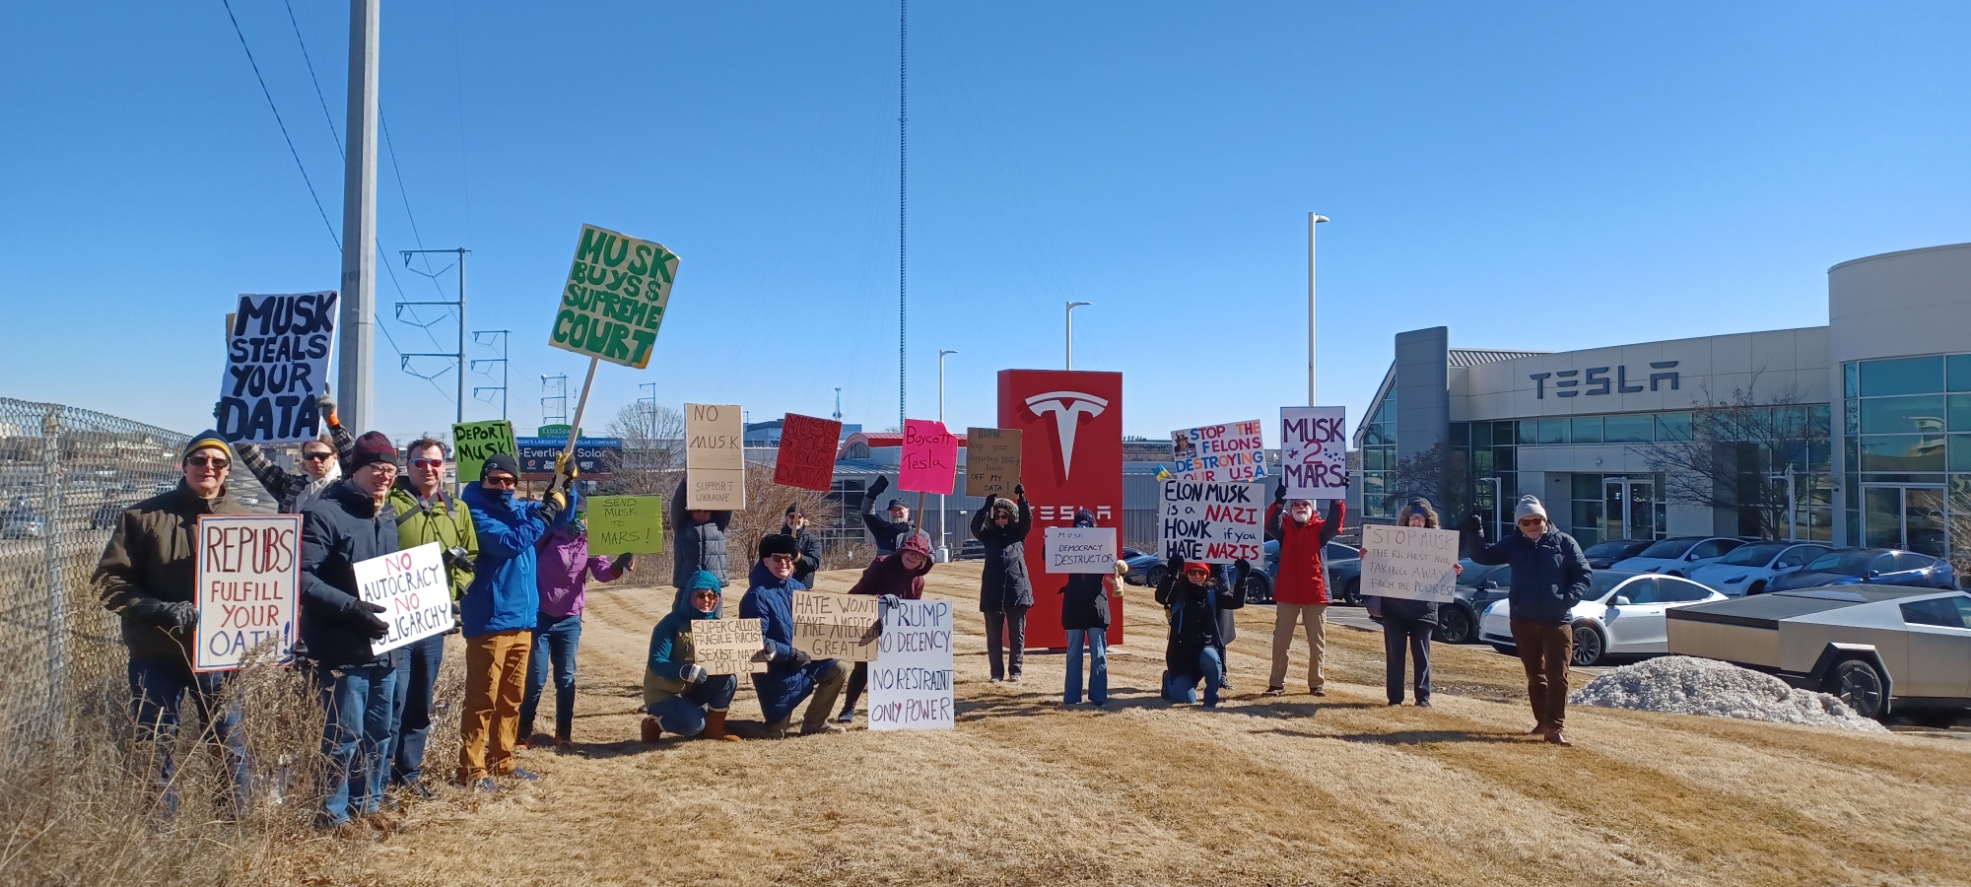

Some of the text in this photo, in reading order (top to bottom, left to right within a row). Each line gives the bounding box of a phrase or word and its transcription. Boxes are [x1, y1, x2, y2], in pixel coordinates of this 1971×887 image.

[576, 228, 679, 285] MUSK
[234, 291, 338, 337] MUSK
[562, 283, 663, 331] SUPREME
[552, 309, 656, 364] COURT
[229, 333, 327, 364] STEALS
[230, 362, 313, 397] YOUR
[1529, 360, 1680, 400] TESLA
[217, 394, 320, 443] DATA
[694, 405, 719, 422] NO
[453, 424, 506, 441] DEPORT
[784, 415, 841, 440] MUSK
[906, 425, 951, 447] Boycott
[1190, 421, 1261, 440] STOP THE
[1283, 418, 1345, 443] MUSK
[523, 448, 606, 458] Everli Solar
[690, 435, 740, 450] MUSK
[780, 433, 835, 454] STOLE
[1202, 437, 1262, 453] FELONS
[1303, 440, 1323, 465] 2
[785, 449, 830, 469] YOUR
[903, 449, 948, 470] Tesla
[1175, 451, 1263, 472] DESTROYING
[696, 481, 734, 492] SUPPORT
[775, 464, 830, 488] DATA
[1284, 464, 1344, 488] MARS
[603, 498, 637, 507] SEND
[695, 493, 730, 503] UKRAINE
[1165, 480, 1250, 503] ELON MUSK
[604, 507, 637, 517] MUSK
[1030, 505, 1111, 520] ESA
[1167, 503, 1257, 525] is a NAZI
[1164, 518, 1257, 544] HONK if you
[1373, 529, 1454, 550] STOP MUSK
[206, 526, 294, 575] REPUBS
[1058, 544, 1103, 552] DEMOCRACY
[1166, 539, 1259, 560] HATE NAZIS
[1372, 548, 1389, 557] THE
[1391, 550, 1430, 561] RICHEST
[385, 553, 412, 575] NO
[1054, 554, 1114, 566] DESTRUCTOR
[1370, 562, 1447, 581] TAKING AWAY
[211, 580, 283, 604] FULFILL
[364, 564, 439, 602] AUTOCRACY
[1371, 578, 1455, 597] FROM THE POOREST
[394, 593, 420, 615] NO
[795, 594, 877, 614] HATE WONT
[879, 601, 947, 627] TRUMP
[221, 604, 279, 629] YOUR
[794, 615, 826, 638] MAKE
[694, 632, 762, 646] FRAGILE RACIST
[898, 630, 951, 653] DECENCY
[697, 648, 734, 663] SEXIST
[715, 660, 755, 674] POTUS
[873, 667, 953, 691] NO RESTRAINT
[871, 697, 951, 723] ONLY POWER
